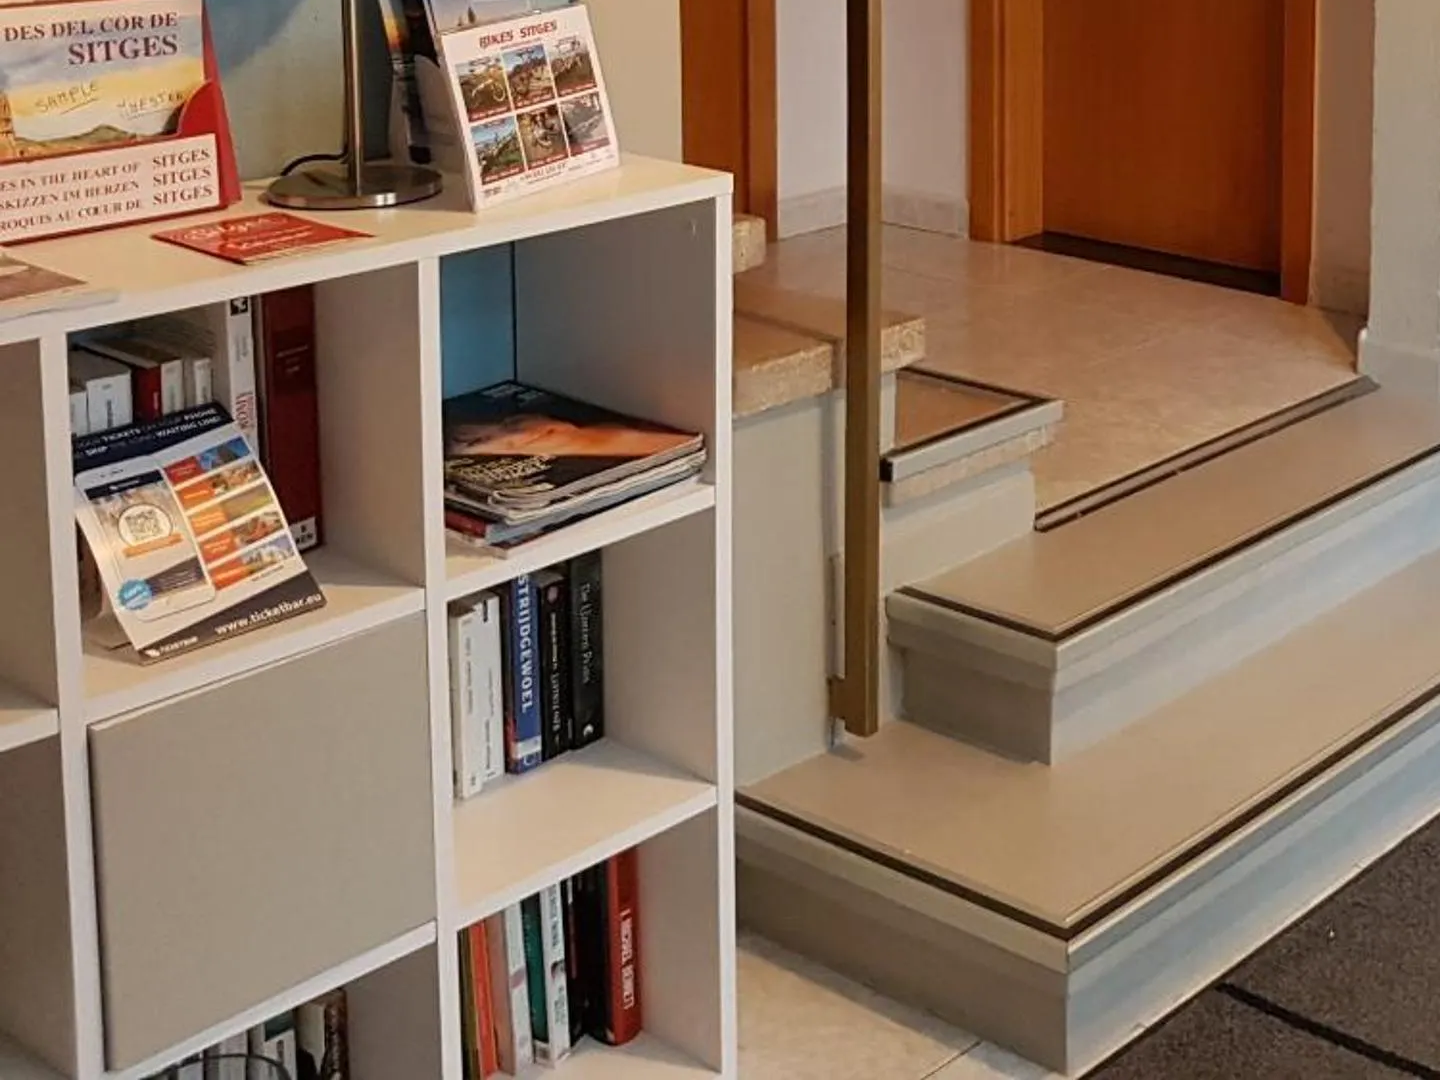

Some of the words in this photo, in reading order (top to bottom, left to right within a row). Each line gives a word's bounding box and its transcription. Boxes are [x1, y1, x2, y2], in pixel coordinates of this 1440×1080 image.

[5, 24, 46, 42] DES
[51, 20, 94, 38] DEL
[100, 15, 145, 33] COR
[150, 12, 178, 29] DE
[68, 33, 178, 66] SITGES
[72, 165, 118, 181] HEART
[152, 148, 211, 169] SITGES
[84, 180, 140, 198] HERZEN
[152, 166, 212, 187] SITGES
[152, 185, 213, 205] SITGES
[517, 573, 534, 714] STRIJDGEWOEL
